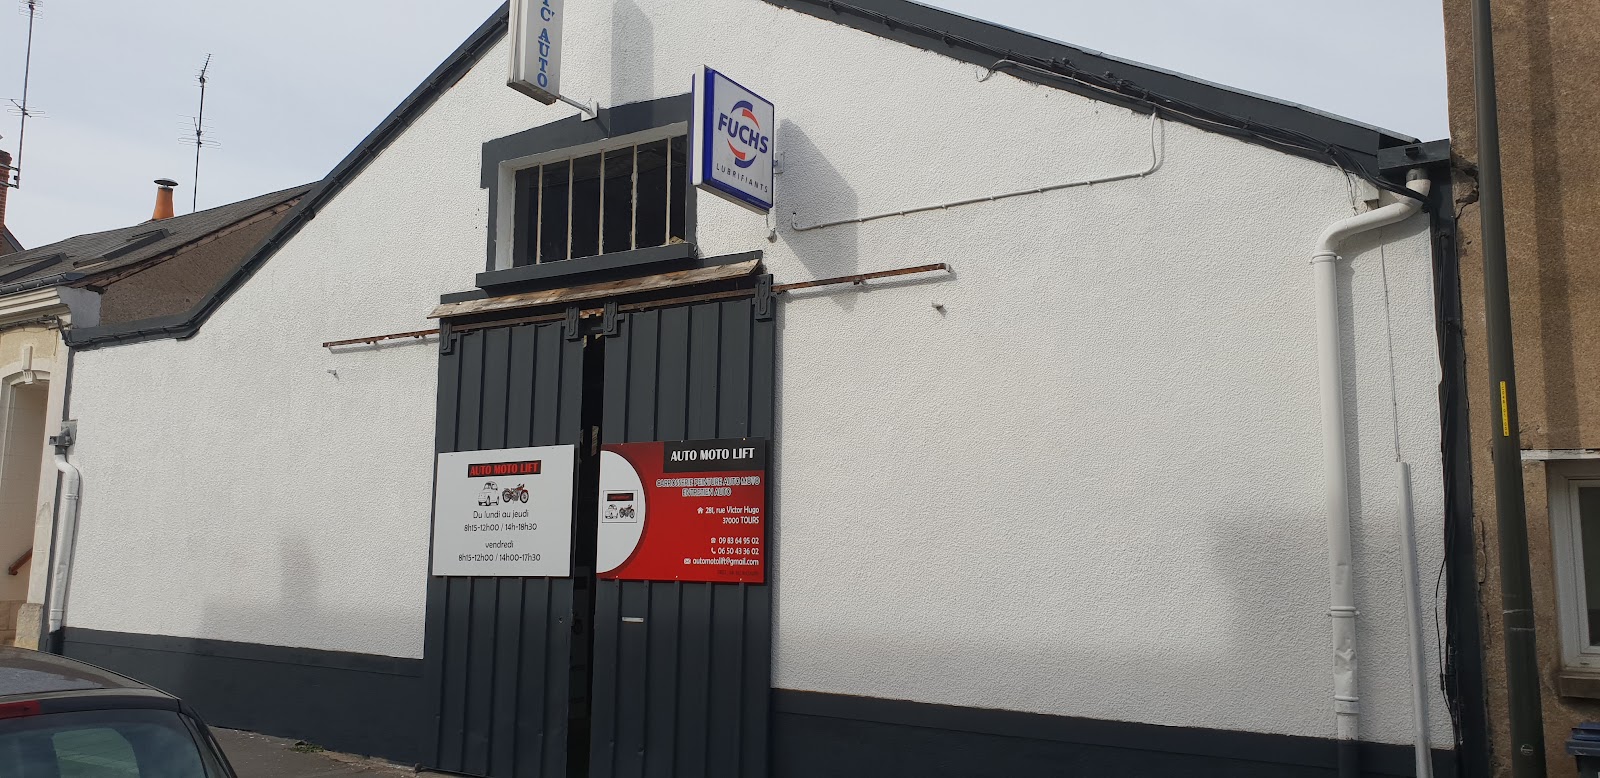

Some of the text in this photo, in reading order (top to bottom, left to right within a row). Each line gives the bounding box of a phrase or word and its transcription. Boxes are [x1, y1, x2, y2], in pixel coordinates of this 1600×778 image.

[537, 28, 550, 88] AUTO
[717, 112, 769, 154] FUCHS
[716, 163, 768, 193] LUBRIFIANTS
[670, 448, 755, 461] AUTO MOTO LIFT
[469, 462, 539, 476] AUTO MOTO LIFT
[656, 476, 760, 488] CARROSSERIE PEINTURE AUTO MOTO
[682, 487, 732, 497] ENTRETIEN AUTO
[473, 511, 482, 519] Du
[484, 510, 500, 518] lundi
[512, 509, 529, 519] jeudi
[726, 506, 743, 514] Victor
[743, 506, 760, 515] Hugo
[740, 516, 759, 524] TOURS
[464, 524, 499, 532] 8h15-12h00
[505, 523, 537, 531] 14h-18h30
[485, 540, 514, 548] vendredi
[717, 547, 759, 555] 06 50 43 36 02
[458, 554, 494, 562] 8h15-12h00
[499, 553, 541, 562] 14h00-17h30
[692, 557, 759, 566] automotolift@gmail.com
